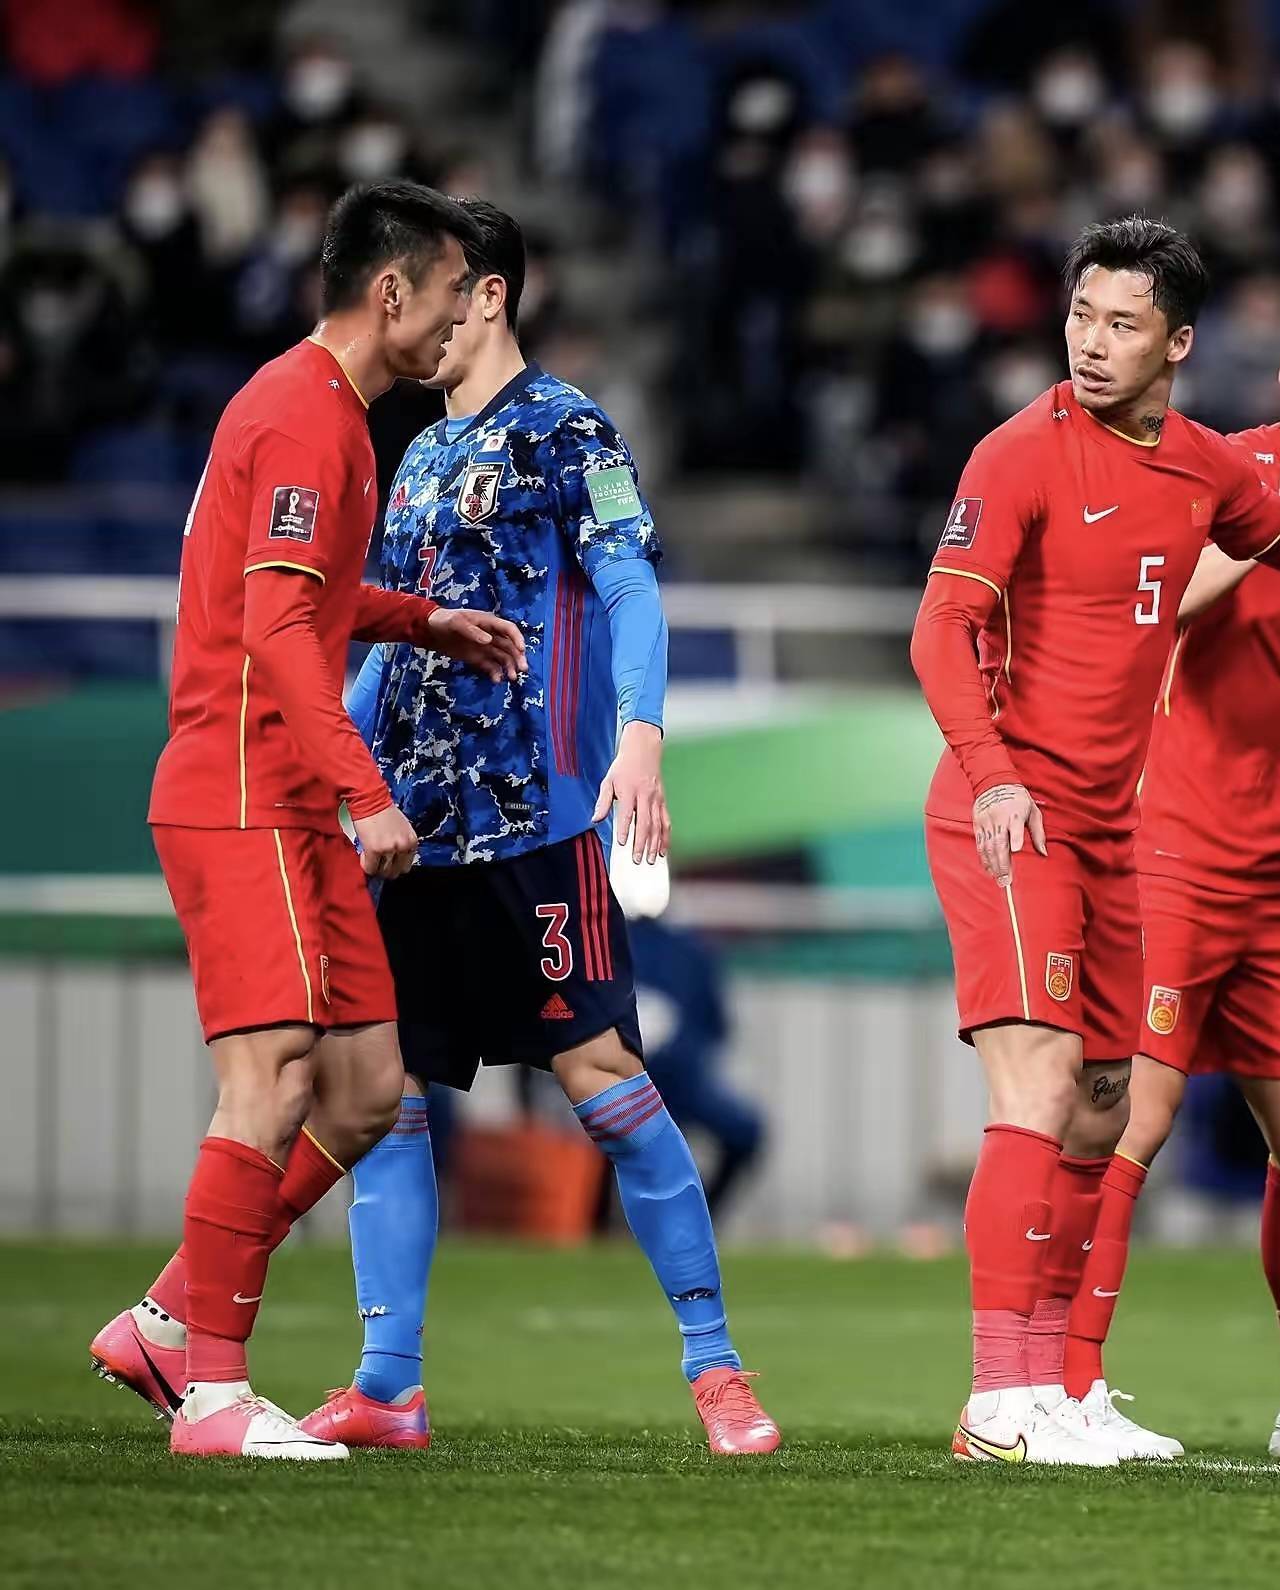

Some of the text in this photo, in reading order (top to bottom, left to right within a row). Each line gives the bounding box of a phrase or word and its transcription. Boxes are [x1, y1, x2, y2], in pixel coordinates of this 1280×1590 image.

[1134, 556, 1165, 625] 5
[535, 902, 573, 982] 3
[1051, 956, 1071, 969] CFA
[540, 1009, 574, 1020] adidas
